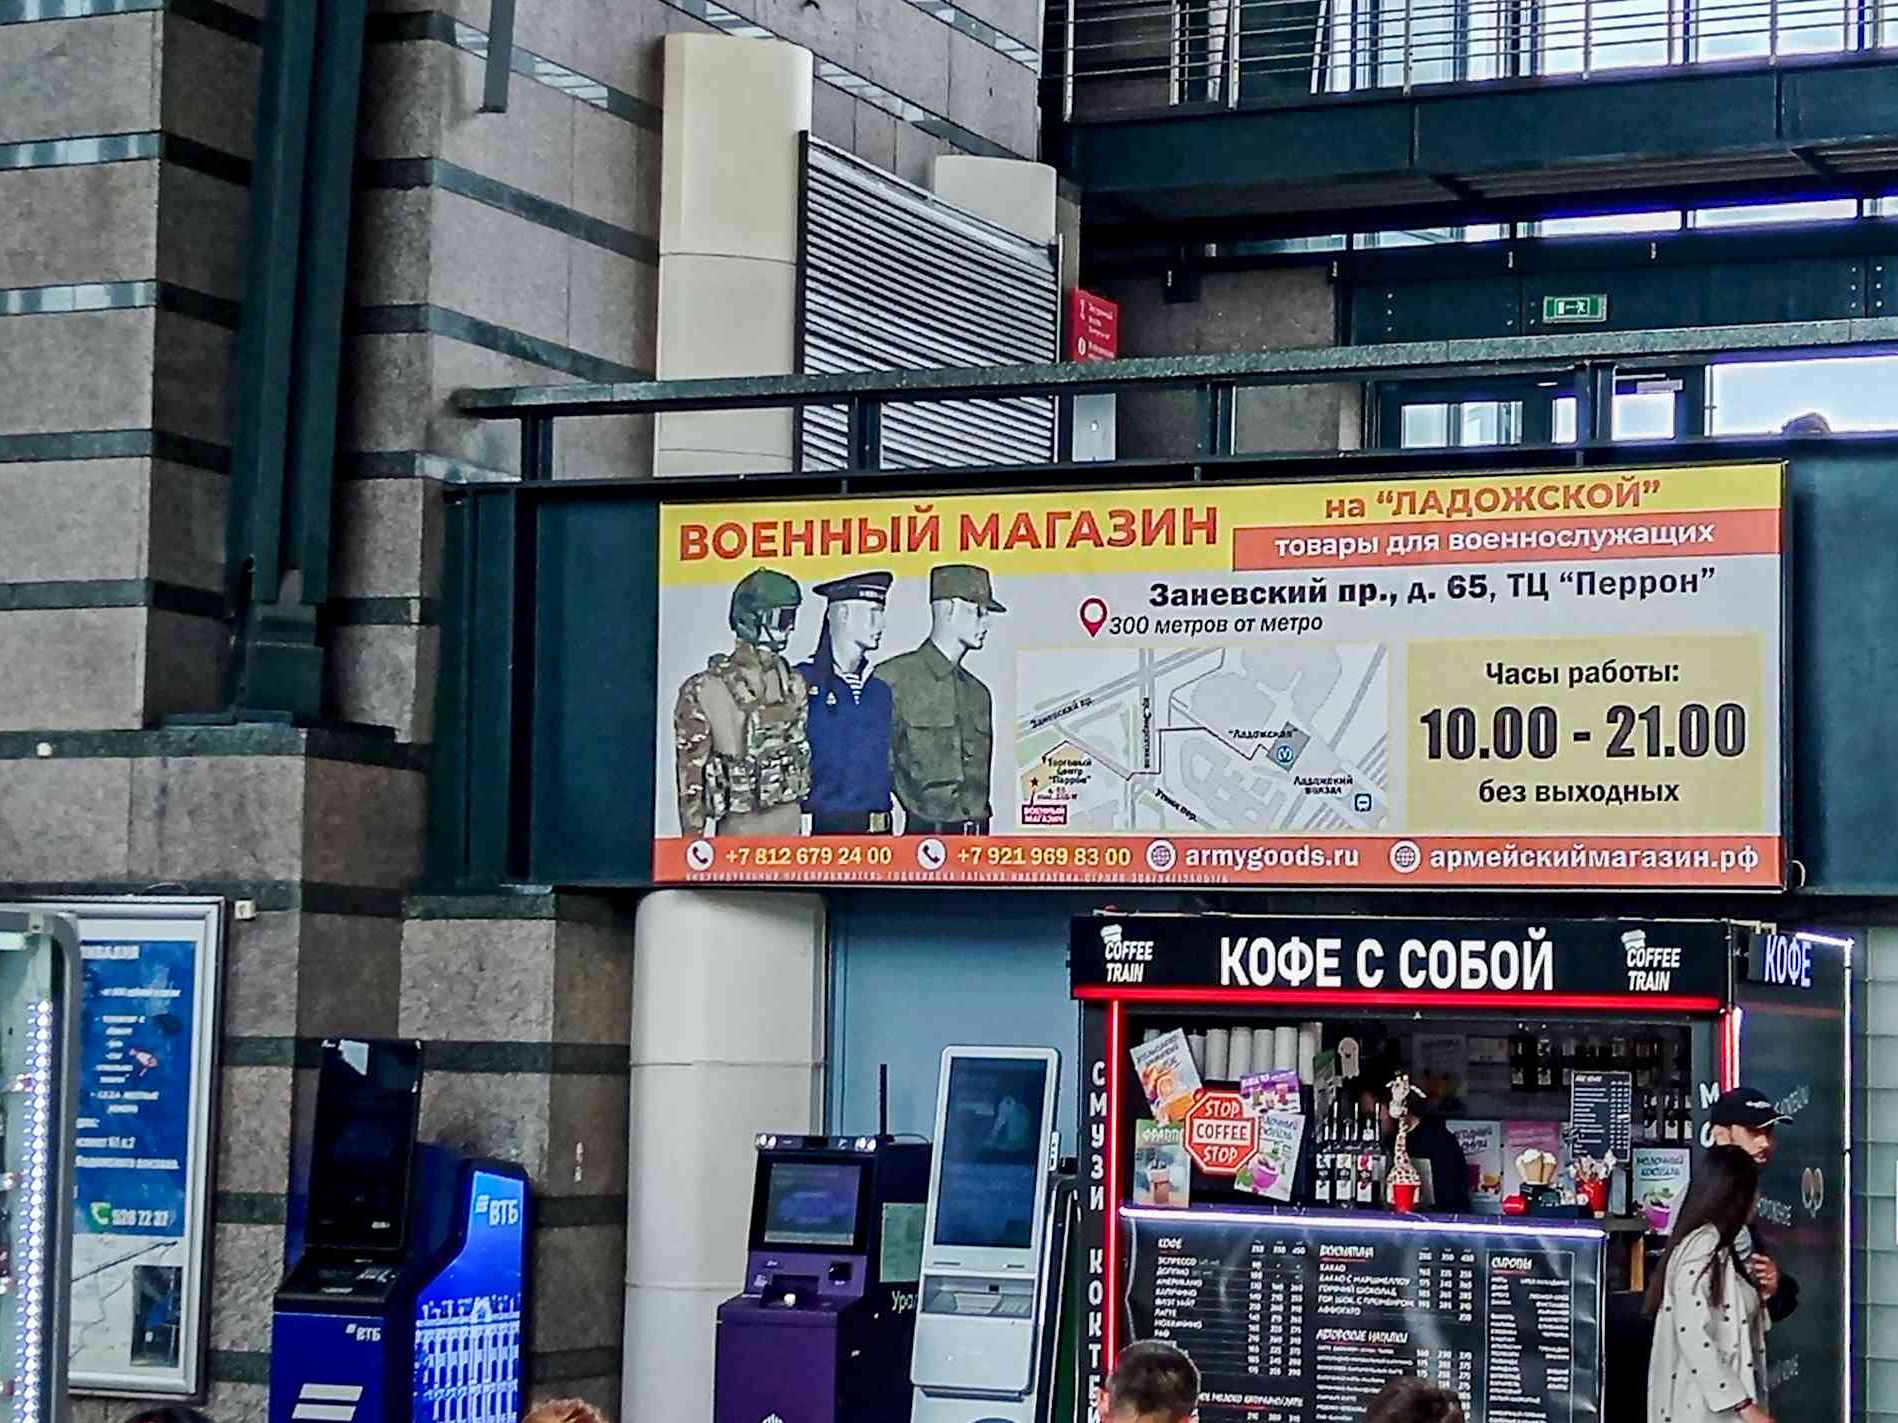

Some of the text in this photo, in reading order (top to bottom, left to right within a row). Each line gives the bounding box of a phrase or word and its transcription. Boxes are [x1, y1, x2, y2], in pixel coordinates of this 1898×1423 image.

[1325, 477, 1662, 519] на “ЛАДОЖСКОЙ”
[679, 505, 1219, 561] ВОЕННЫЙ МАГАЗИН
[1274, 523, 1715, 560] товары для военнослужащих
[1149, 567, 1717, 609] Заневский пр., д. 65, ТЦ “Перрон”
[1109, 614, 1324, 640] 300 метров от метро
[1486, 660, 1680, 687] Часы работы:
[1419, 702, 1747, 760] 10.00 - 21.00
[1478, 779, 1680, 805] без выходных
[725, 847, 893, 865] +7 812 679 24 00
[957, 847, 1132, 866] +7 921 969 83 00
[1185, 845, 1360, 872] armygoods.ru
[1429, 842, 1760, 874] армейскиймагазин.рф
[1104, 941, 1154, 961] COFFEE
[1220, 926, 1554, 990] КОФЕ С СОБОЙ
[1626, 947, 1682, 968] COFFEE
[1764, 934, 1812, 988] КОФЕ
[1106, 962, 1144, 982] TRAIN
[1628, 970, 1671, 991] TRAIN
[1205, 1100, 1240, 1117] STOP
[1197, 1124, 1248, 1141] COFFEE
[1203, 1146, 1239, 1162] STOP
[488, 1199, 519, 1226] ВТБ
[1319, 1264, 1346, 1272] КАКАО
[355, 1326, 382, 1342] ВТБ
